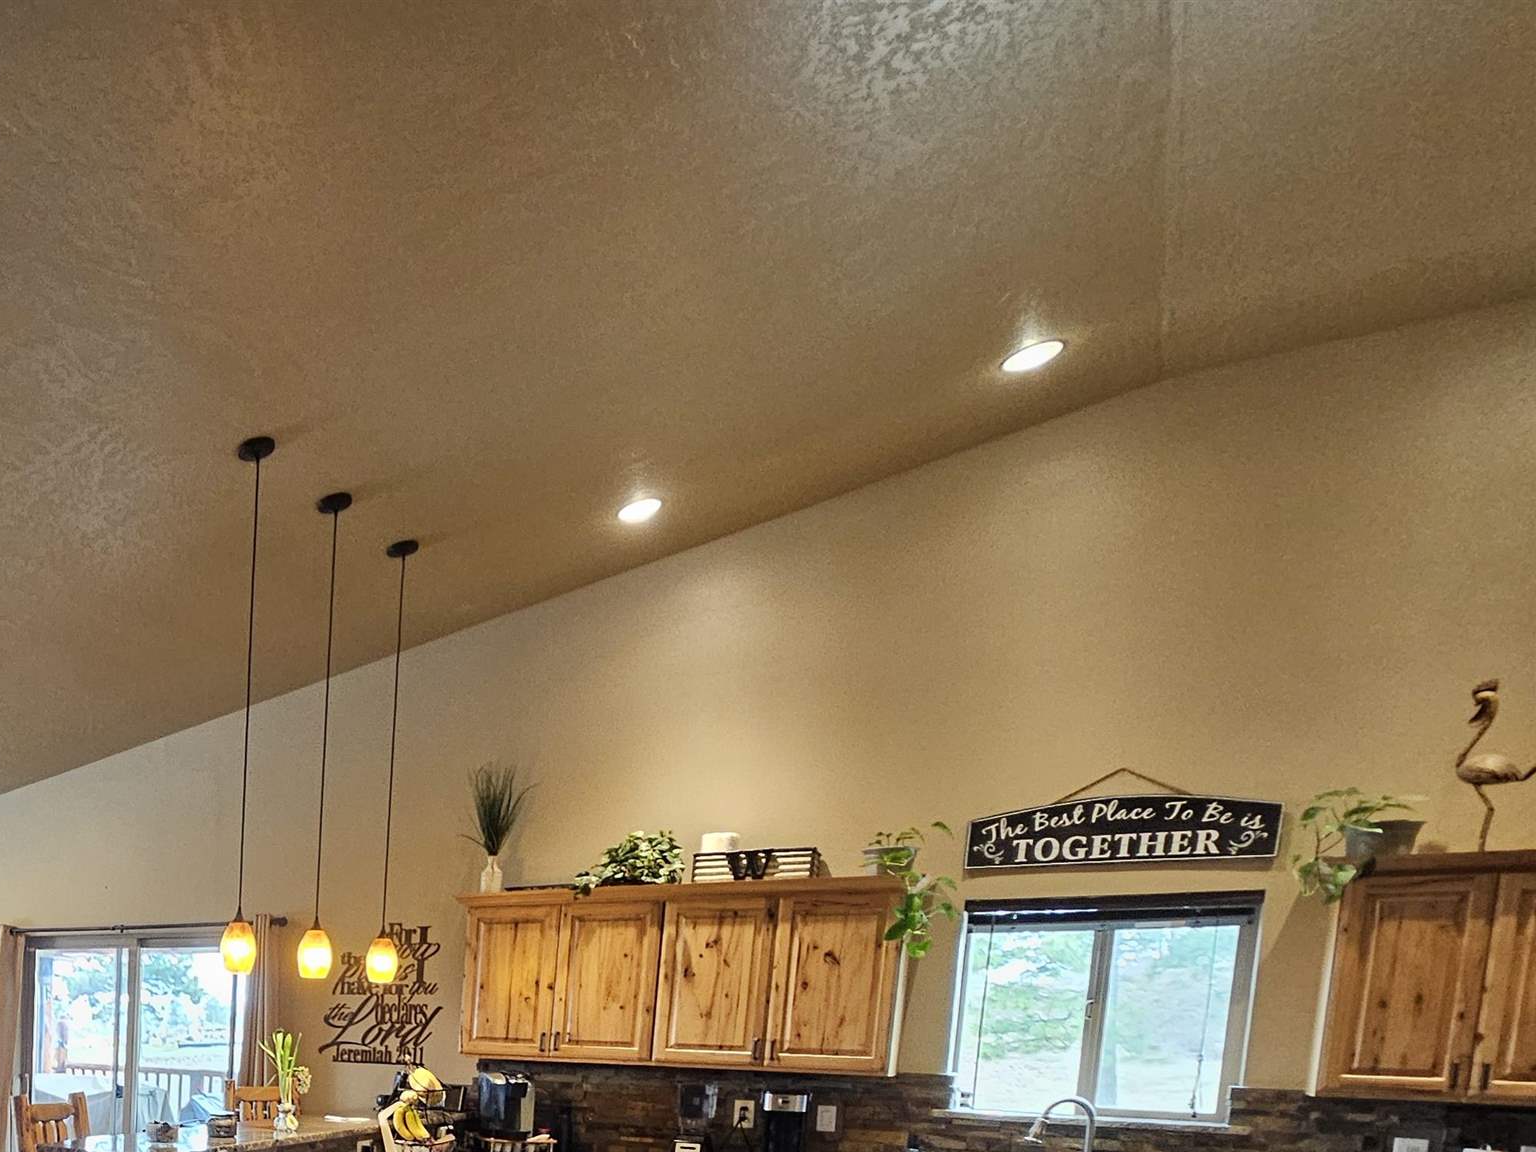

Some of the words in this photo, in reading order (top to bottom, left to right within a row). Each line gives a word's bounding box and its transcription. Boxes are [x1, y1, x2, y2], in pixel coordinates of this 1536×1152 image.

[981, 821, 1028, 845] The
[1033, 805, 1085, 832] Best
[1091, 799, 1156, 824] Place
[1164, 800, 1194, 821] To
[1201, 802, 1234, 824] Be
[1240, 812, 1265, 830] is
[1013, 829, 1220, 864] TOGETHER
[318, 992, 444, 1055] Lord
[375, 993, 428, 1025] declares
[332, 1044, 393, 1063] Jeremiah
